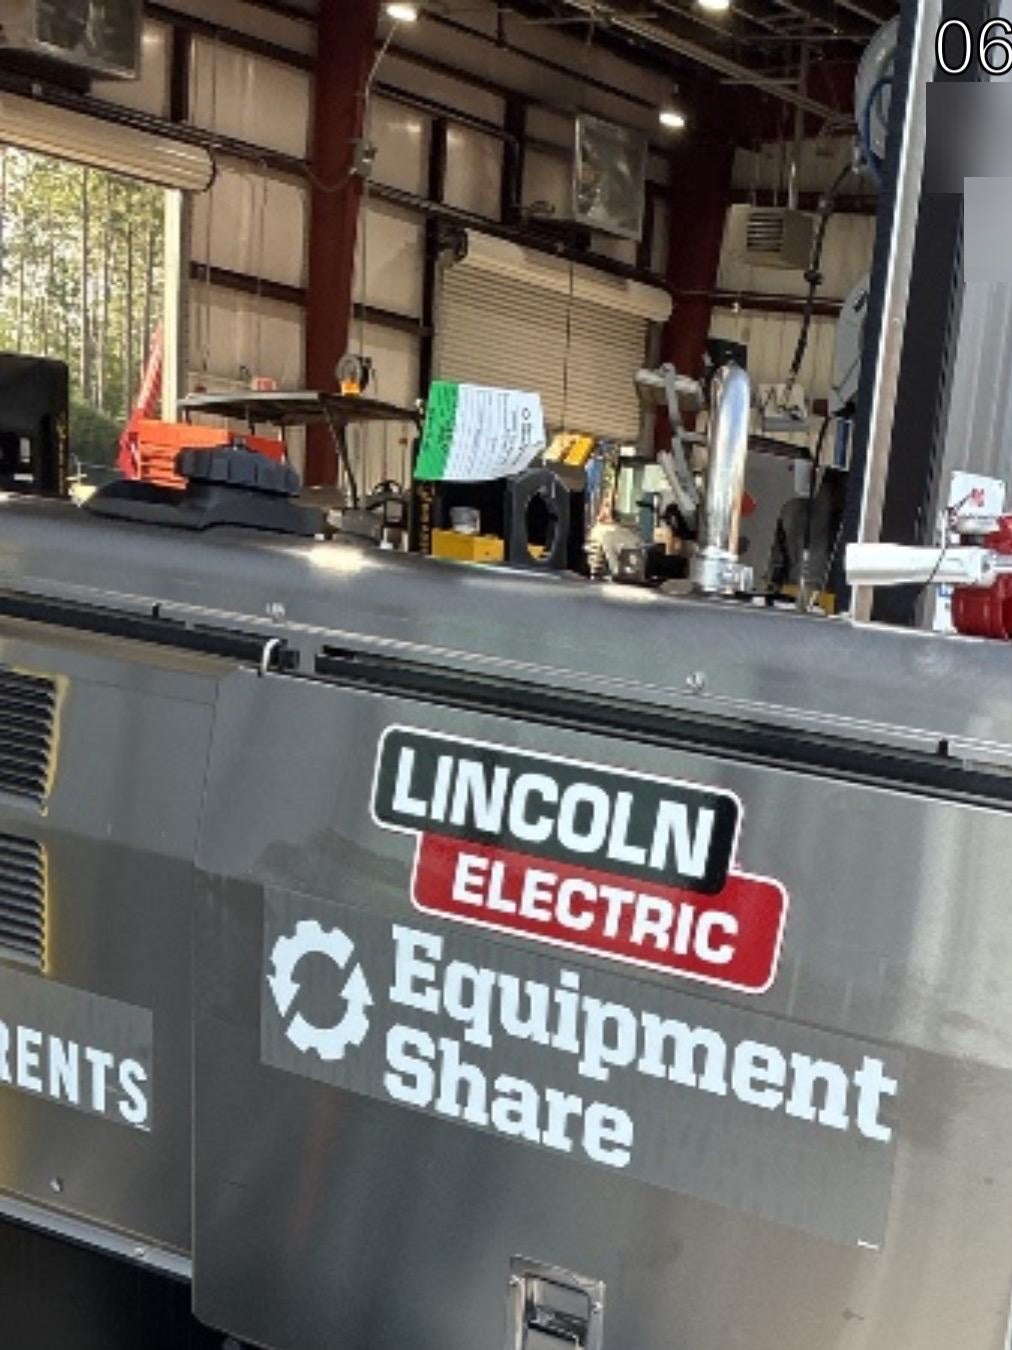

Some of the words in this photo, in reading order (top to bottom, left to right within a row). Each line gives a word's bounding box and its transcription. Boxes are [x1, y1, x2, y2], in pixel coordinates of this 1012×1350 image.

[393, 747, 714, 877] LINCOLN
[453, 853, 737, 963] ELECTRIC
[385, 1024, 634, 1168] Share
[390, 924, 897, 1143] Equipment
